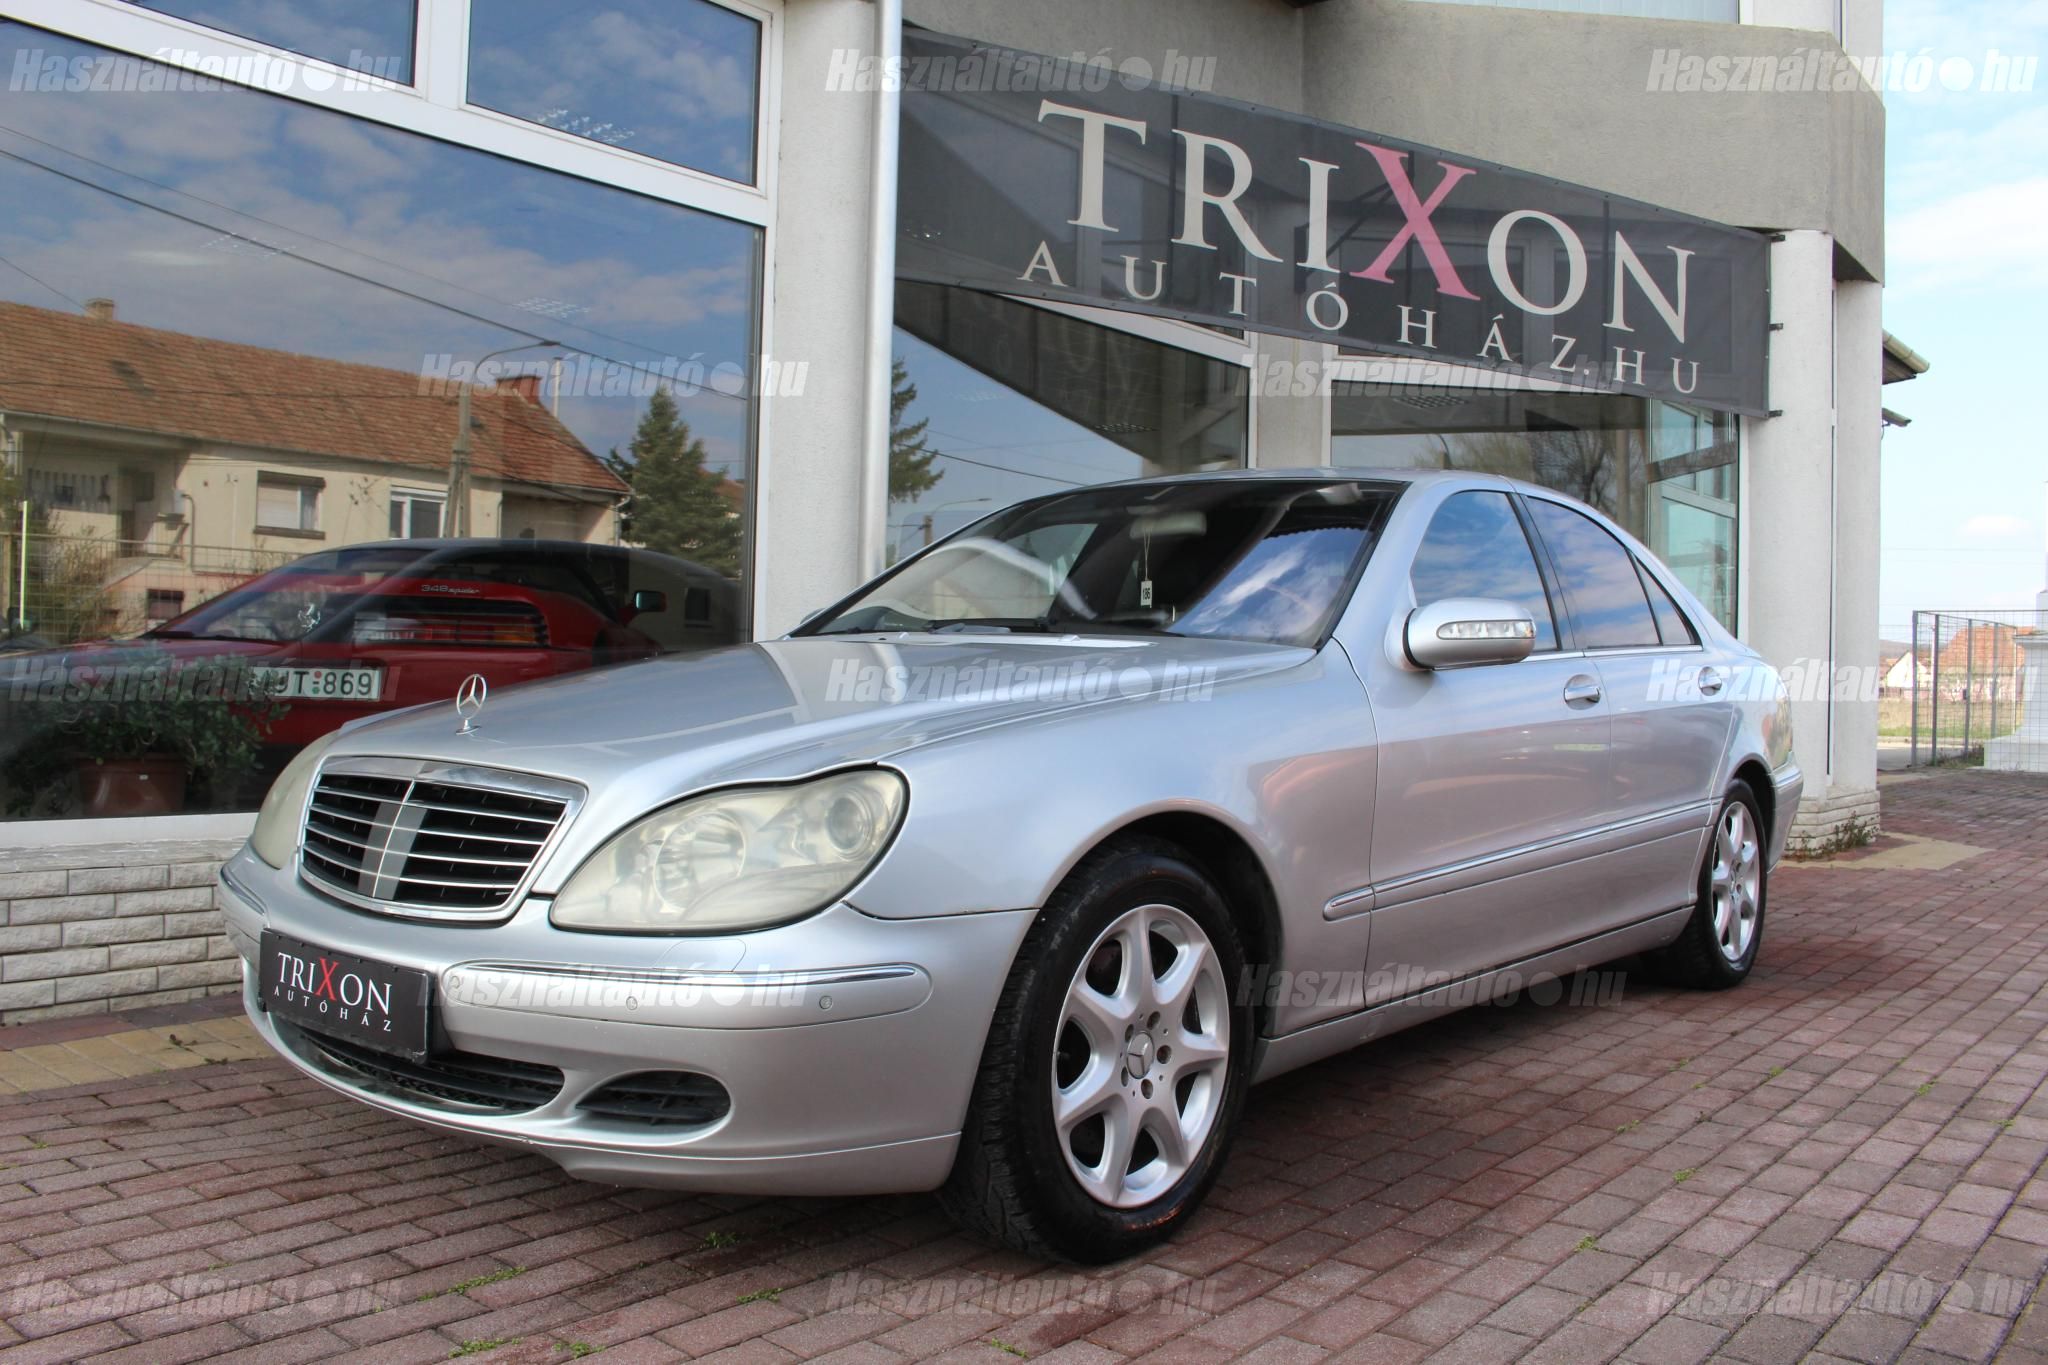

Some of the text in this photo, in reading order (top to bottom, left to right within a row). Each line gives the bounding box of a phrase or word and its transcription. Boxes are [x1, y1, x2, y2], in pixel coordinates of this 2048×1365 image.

[1037, 99, 1697, 344] TRIXON
[273, 985, 392, 1032] AUTÓHÁZ
[277, 951, 393, 1016] TRIXON
